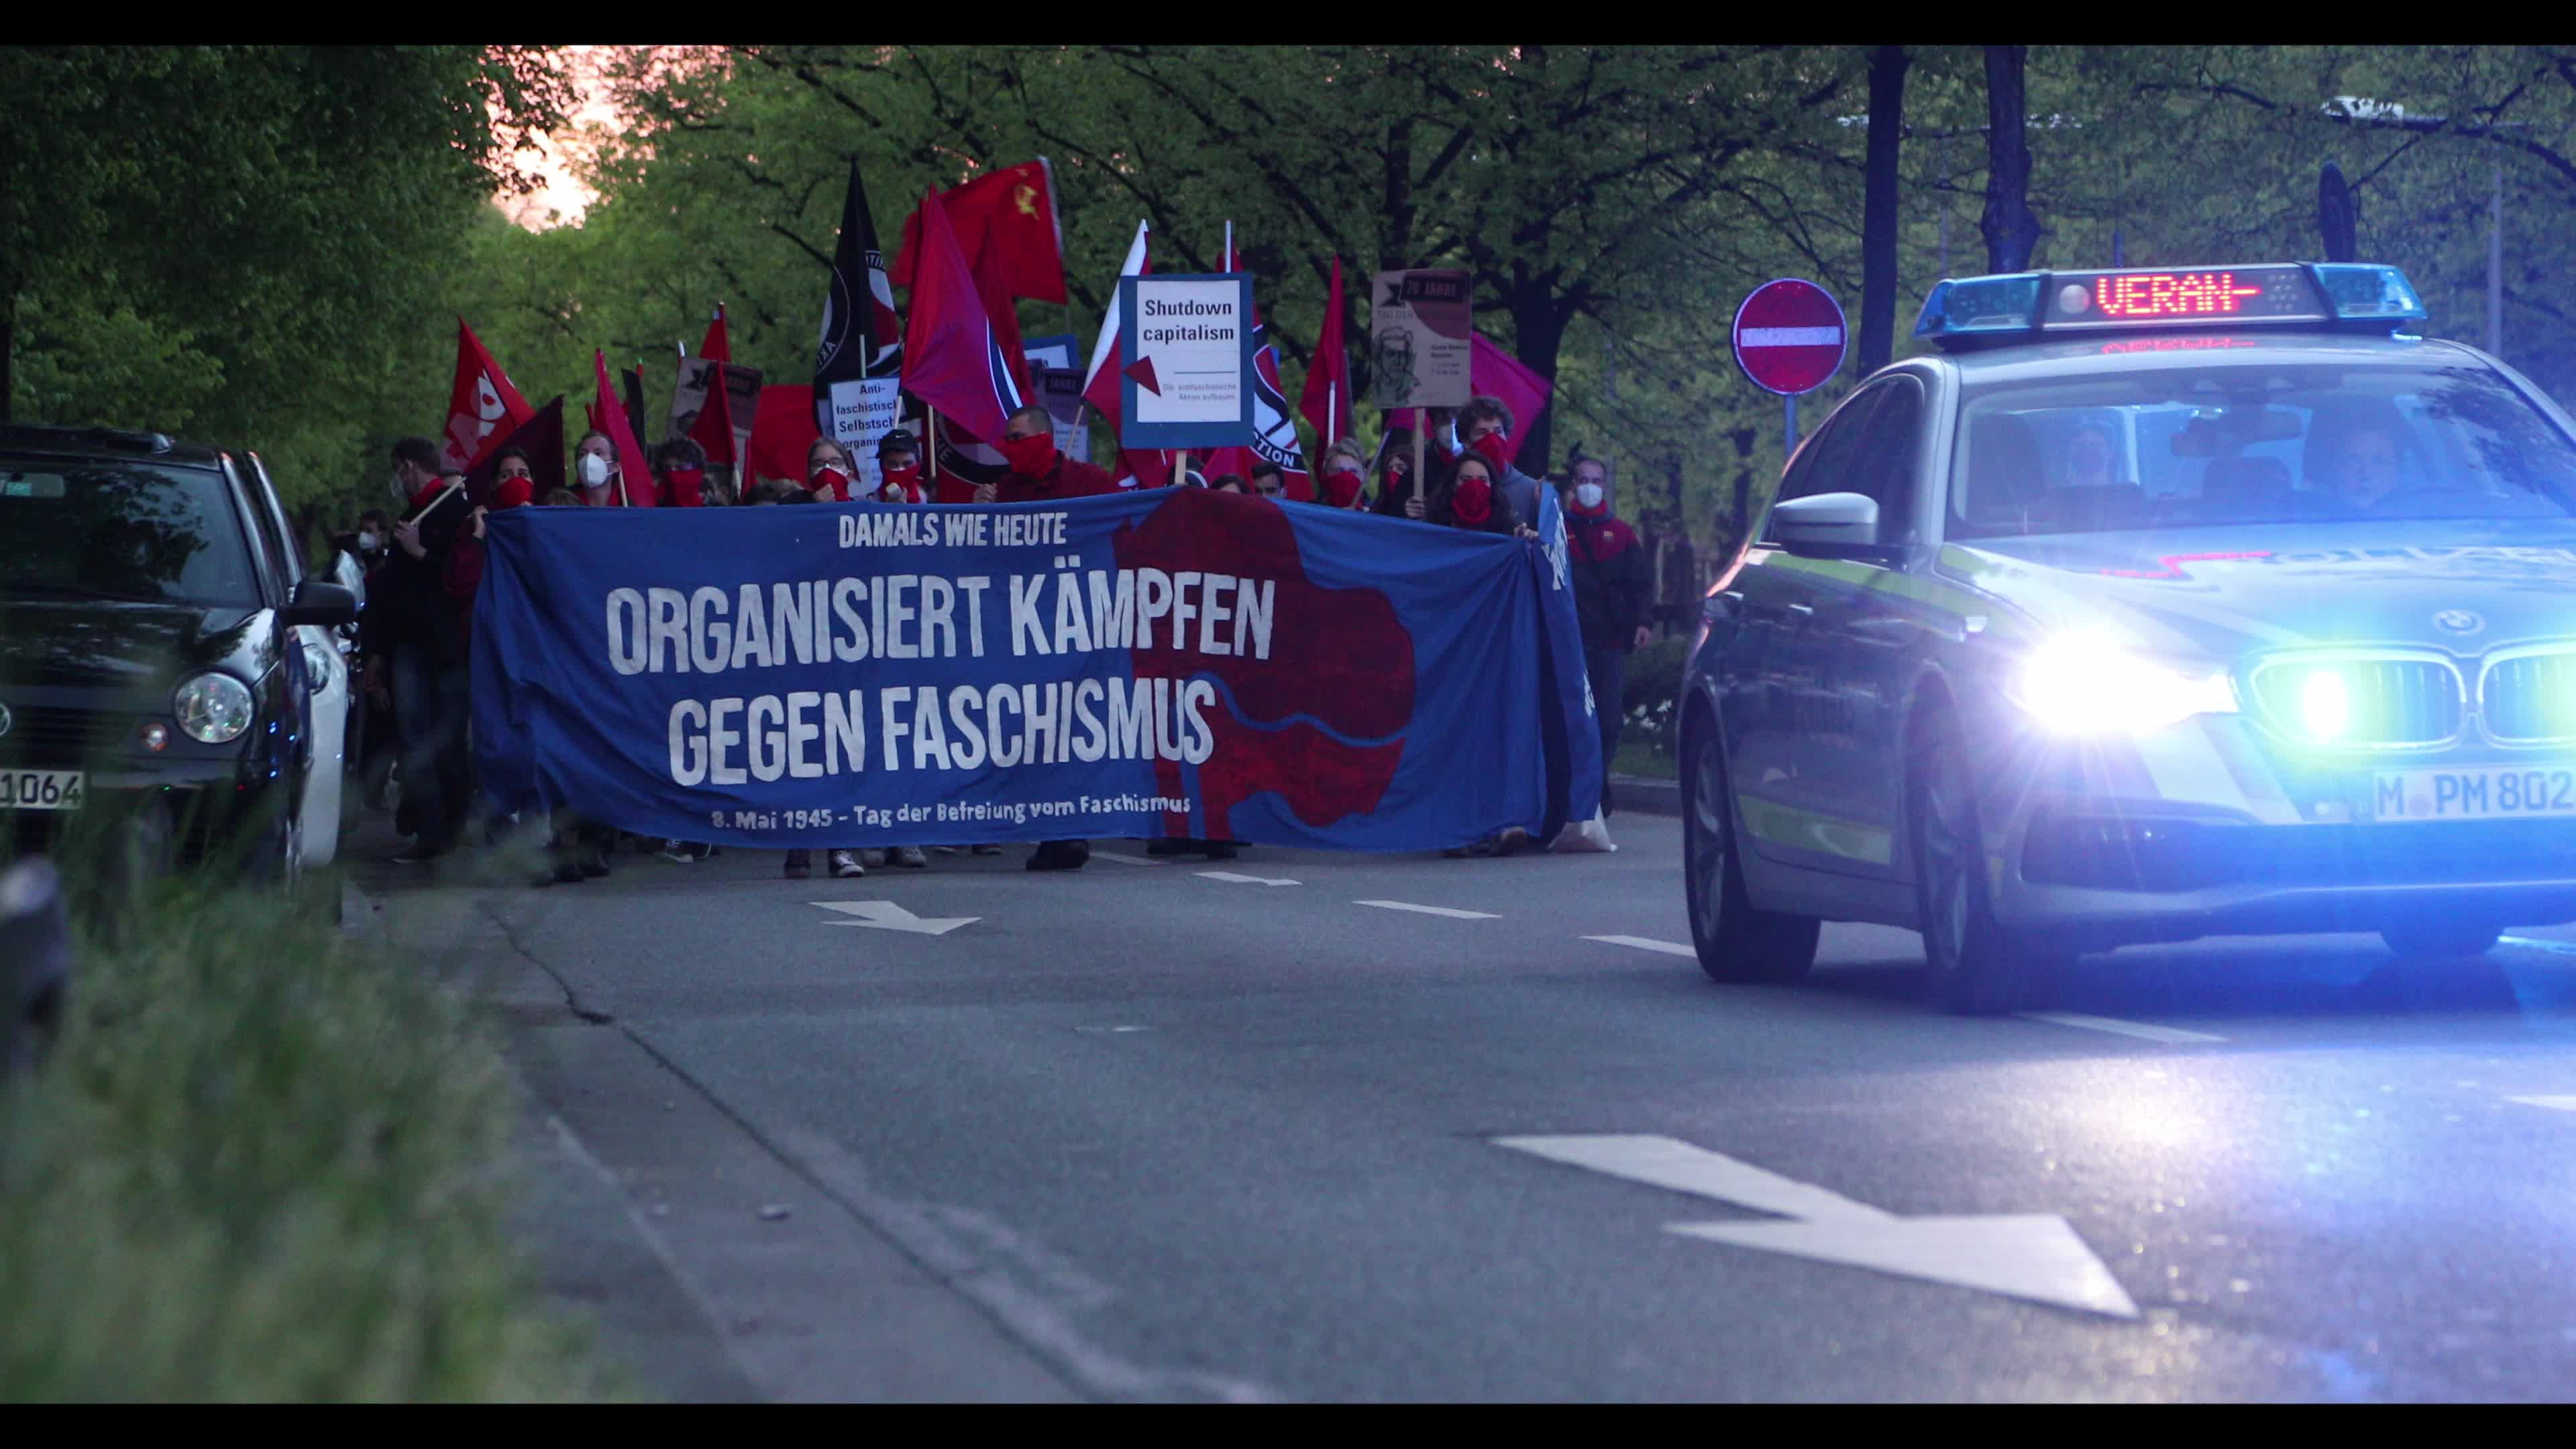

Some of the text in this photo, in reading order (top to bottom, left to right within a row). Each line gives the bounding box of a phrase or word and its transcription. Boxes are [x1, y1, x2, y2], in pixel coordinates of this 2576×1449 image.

[1144, 299, 1232, 316] Shutdown
[2097, 274, 2261, 314] VERAN-
[1143, 325, 1234, 345] capitalism
[859, 384, 886, 395] Anti-
[1252, 431, 1295, 468] TION
[839, 512, 1069, 548] DAMALS WIE HEUTE
[606, 555, 1275, 676] ORGANISIERT KÄMPFEN
[669, 676, 1216, 786] GEGEN FASCHISMUS
[1, 773, 80, 804] 1064
[2377, 770, 2575, 815] M PM 802
[711, 810, 731, 828] 8.
[735, 811, 777, 830] Mai
[783, 808, 833, 830] 1945
[853, 805, 893, 828] Tag
[896, 803, 932, 822] der
[937, 800, 1026, 824] Befreiung
[1029, 801, 1075, 818] vom
[1079, 793, 1191, 814] Faschismus
